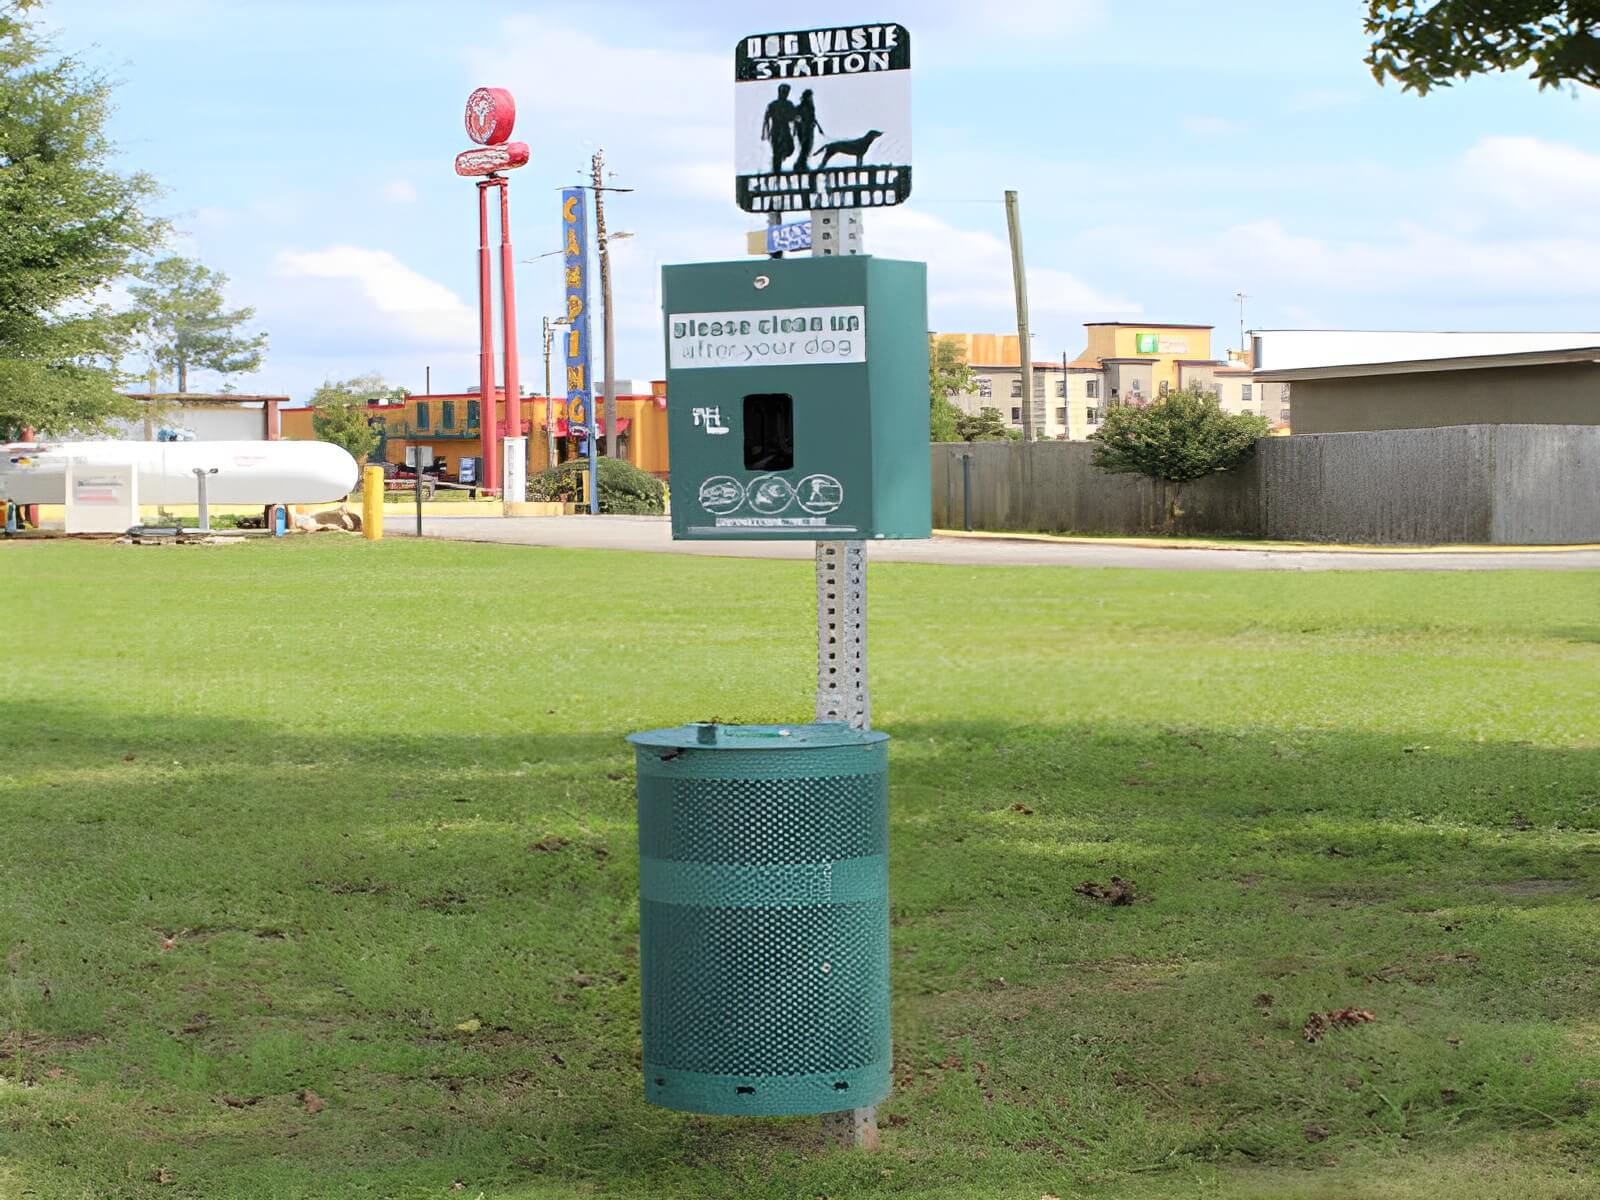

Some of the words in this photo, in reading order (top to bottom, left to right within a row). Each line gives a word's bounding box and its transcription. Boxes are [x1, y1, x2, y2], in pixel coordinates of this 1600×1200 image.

[747, 34, 800, 58] DOG
[809, 25, 899, 53] WASTE
[756, 53, 890, 79] STATION
[562, 196, 587, 424] CAMPING
[743, 341, 797, 361] your
[804, 336, 852, 357] dog
